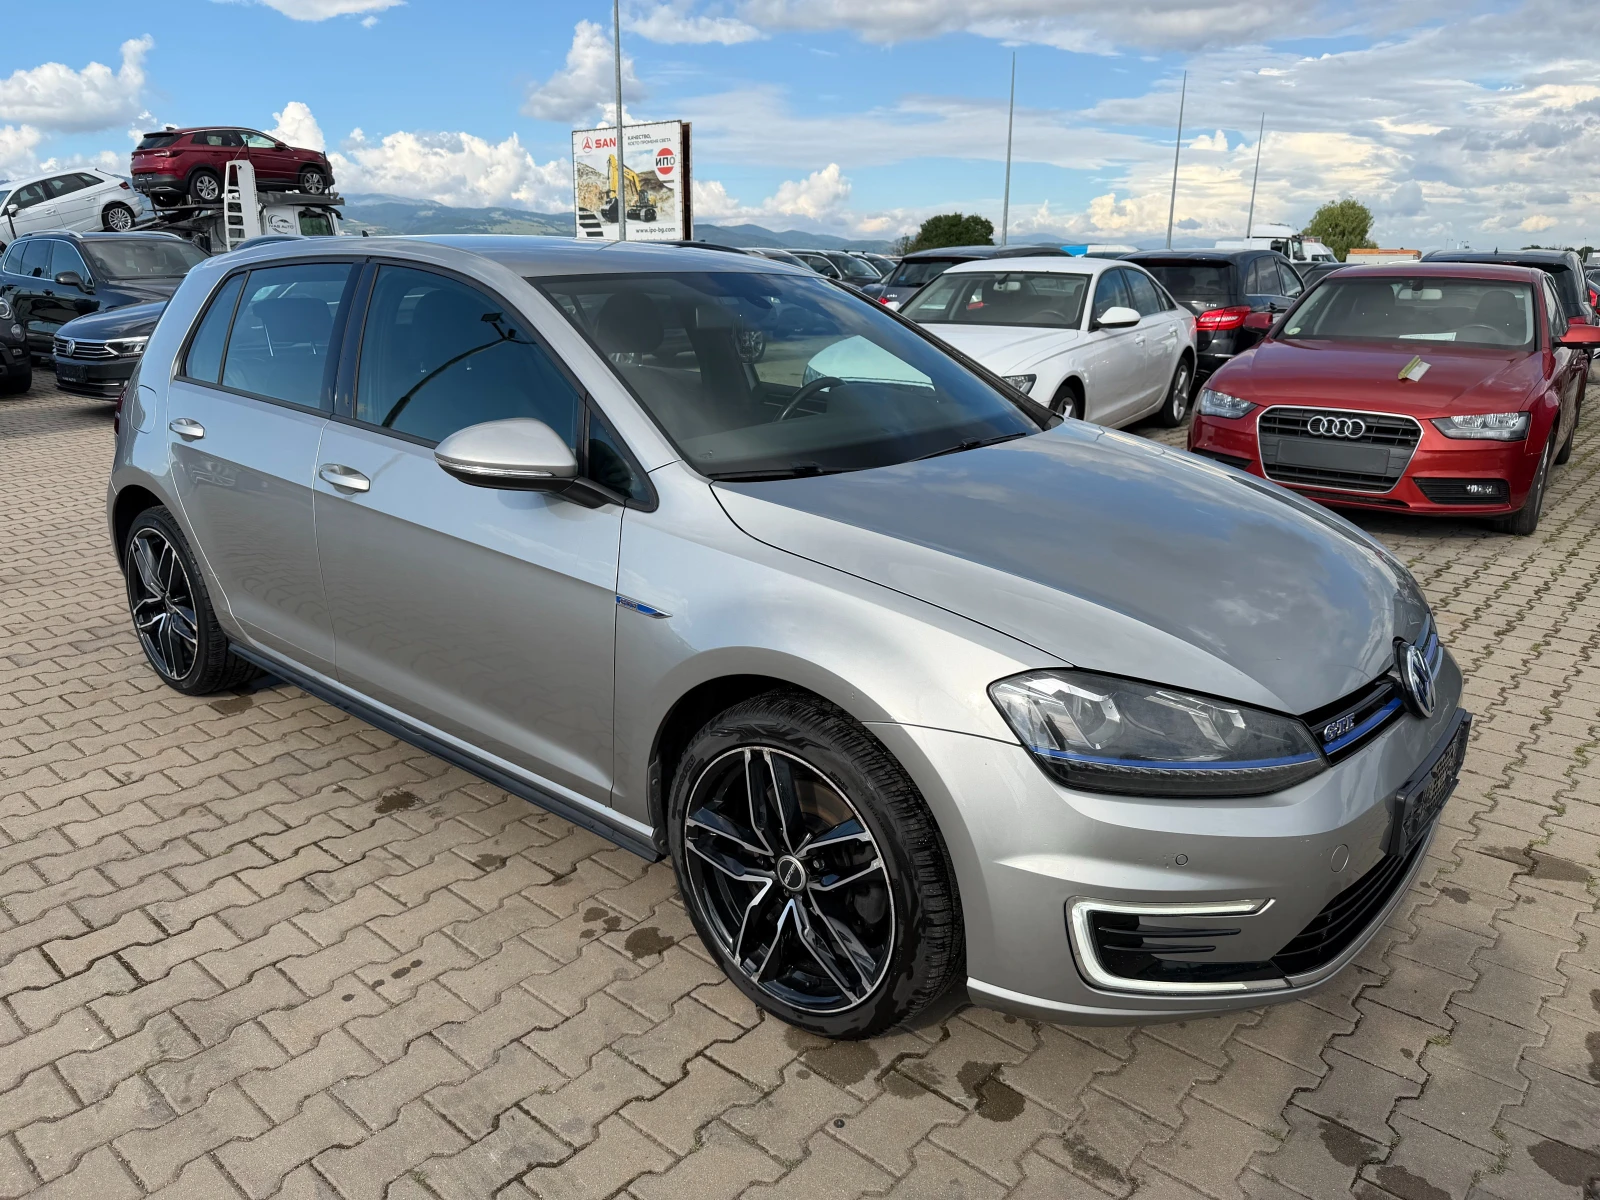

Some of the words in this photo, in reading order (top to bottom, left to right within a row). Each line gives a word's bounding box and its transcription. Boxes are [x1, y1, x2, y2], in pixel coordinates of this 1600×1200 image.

[595, 138, 616, 148] SAN
[656, 157, 675, 166] ИПО
[1324, 712, 1355, 742] GTE
